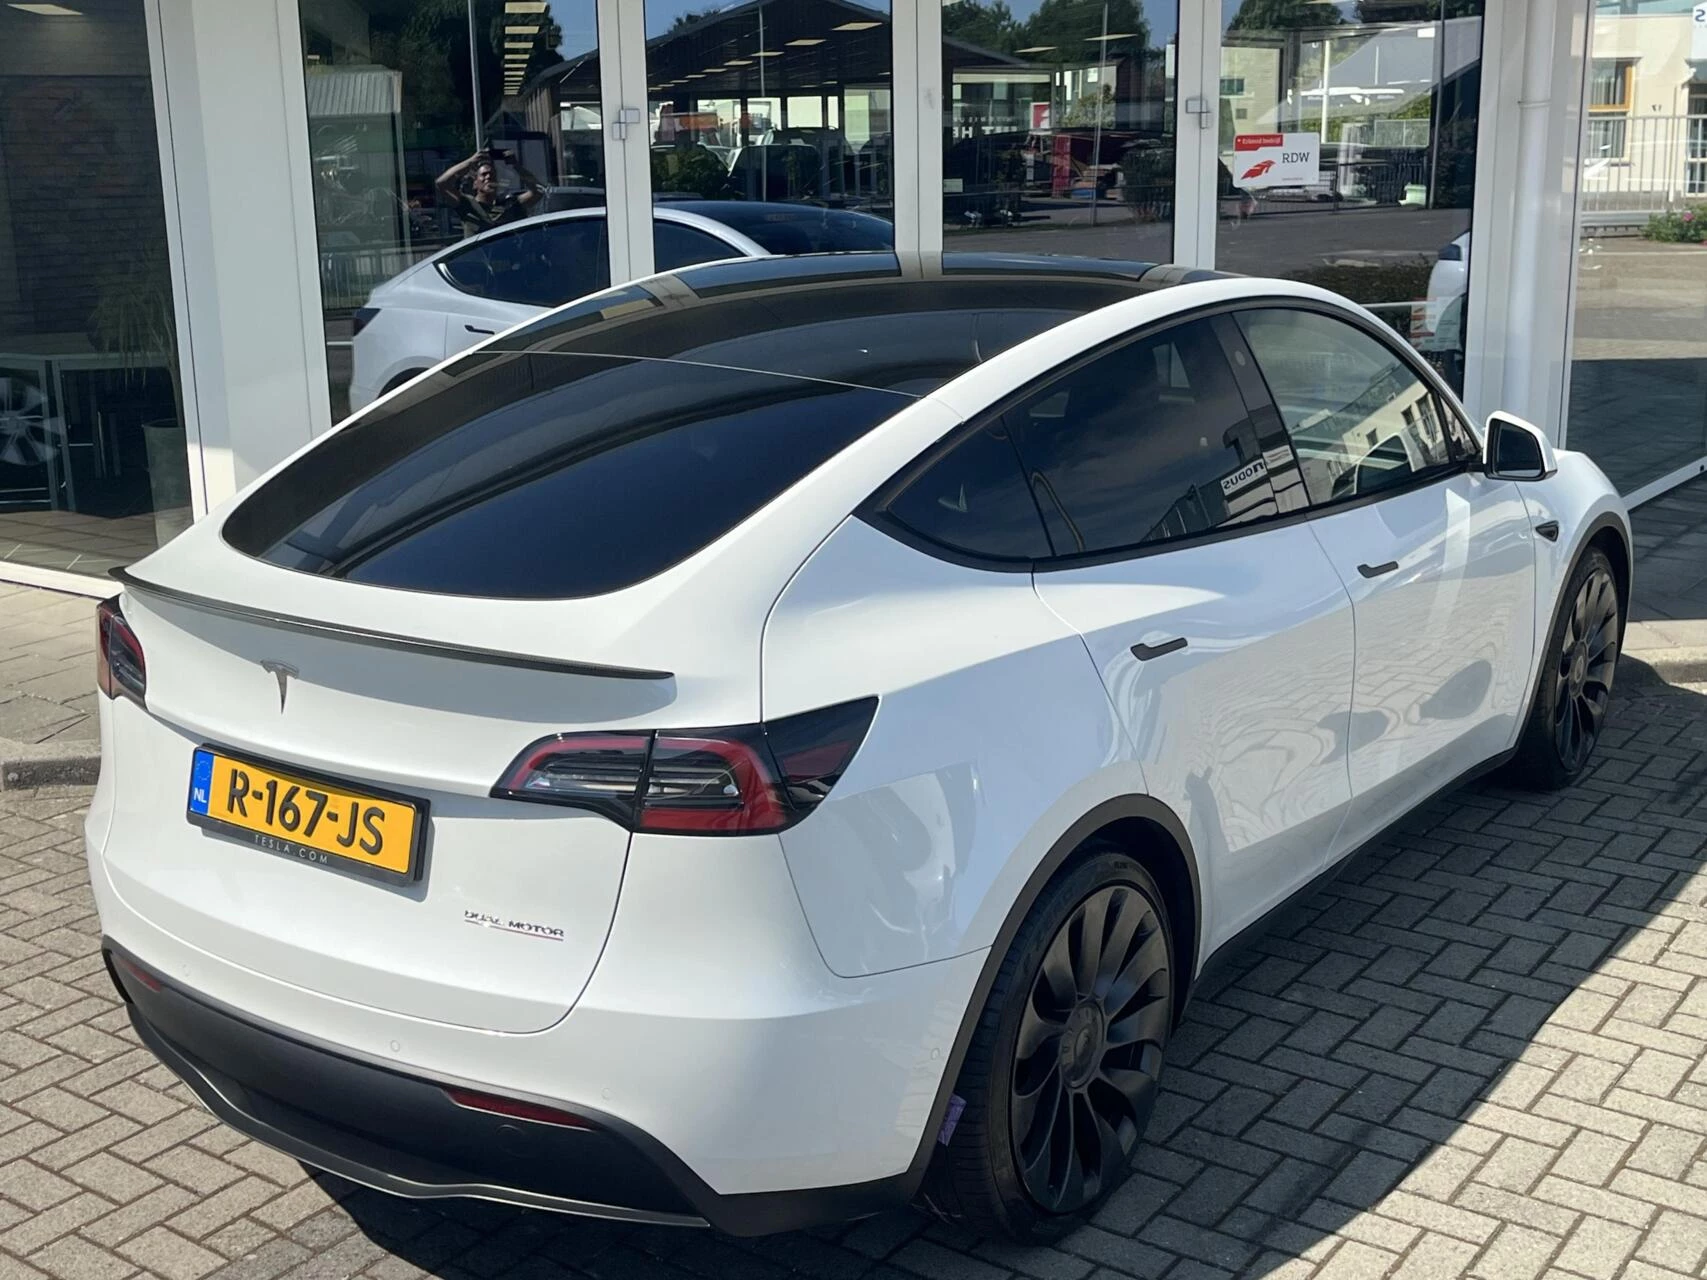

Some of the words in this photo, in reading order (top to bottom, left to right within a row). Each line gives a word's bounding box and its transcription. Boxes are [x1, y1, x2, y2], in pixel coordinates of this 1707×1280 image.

[1282, 152, 1310, 163] RDW
[193, 787, 208, 804] NL
[226, 768, 386, 856] R-167-JS
[254, 834, 329, 865] TESLA.COM
[508, 920, 565, 937] MOTOR
